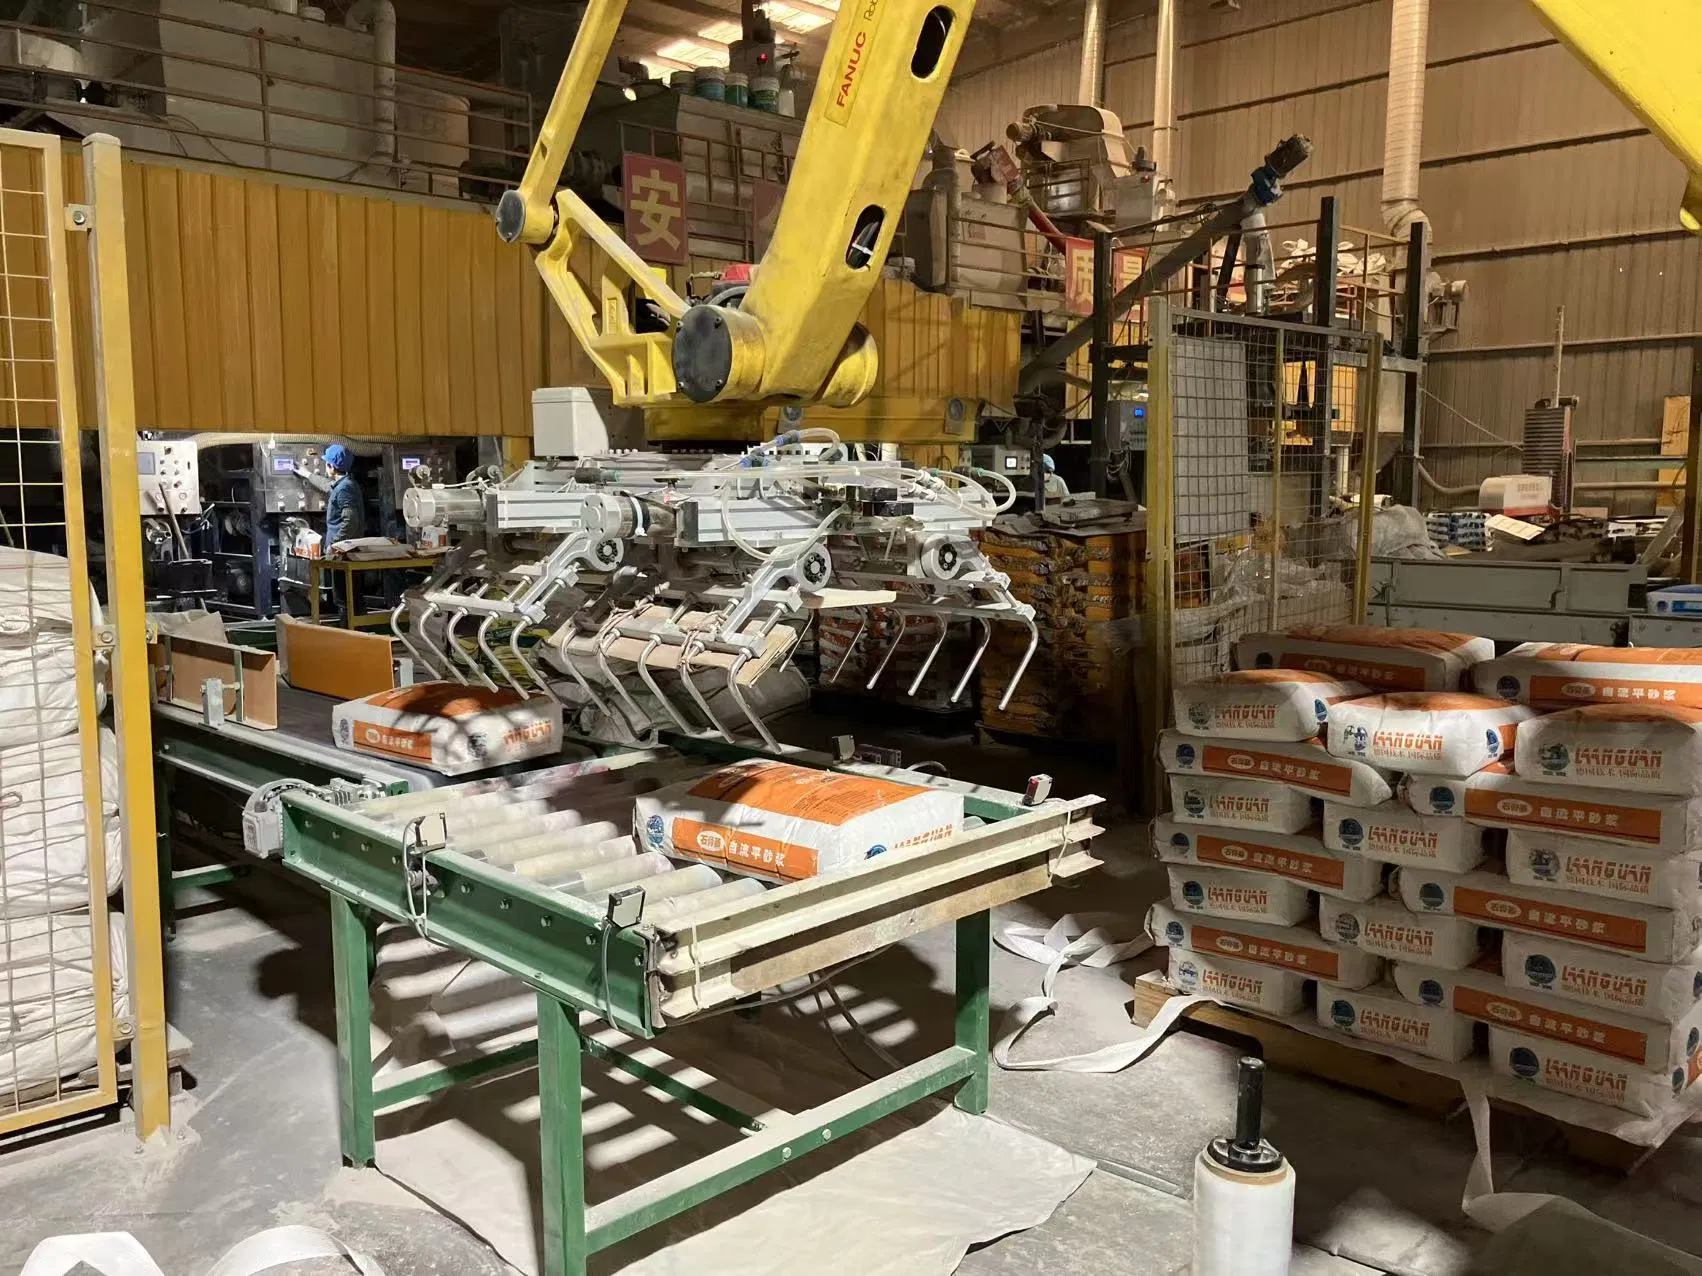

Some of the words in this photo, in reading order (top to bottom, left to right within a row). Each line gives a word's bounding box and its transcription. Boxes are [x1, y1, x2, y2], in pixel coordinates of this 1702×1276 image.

[836, 31, 866, 108] FANUC
[631, 168, 682, 251] 安
[728, 841, 785, 868] 自流平砂浆
